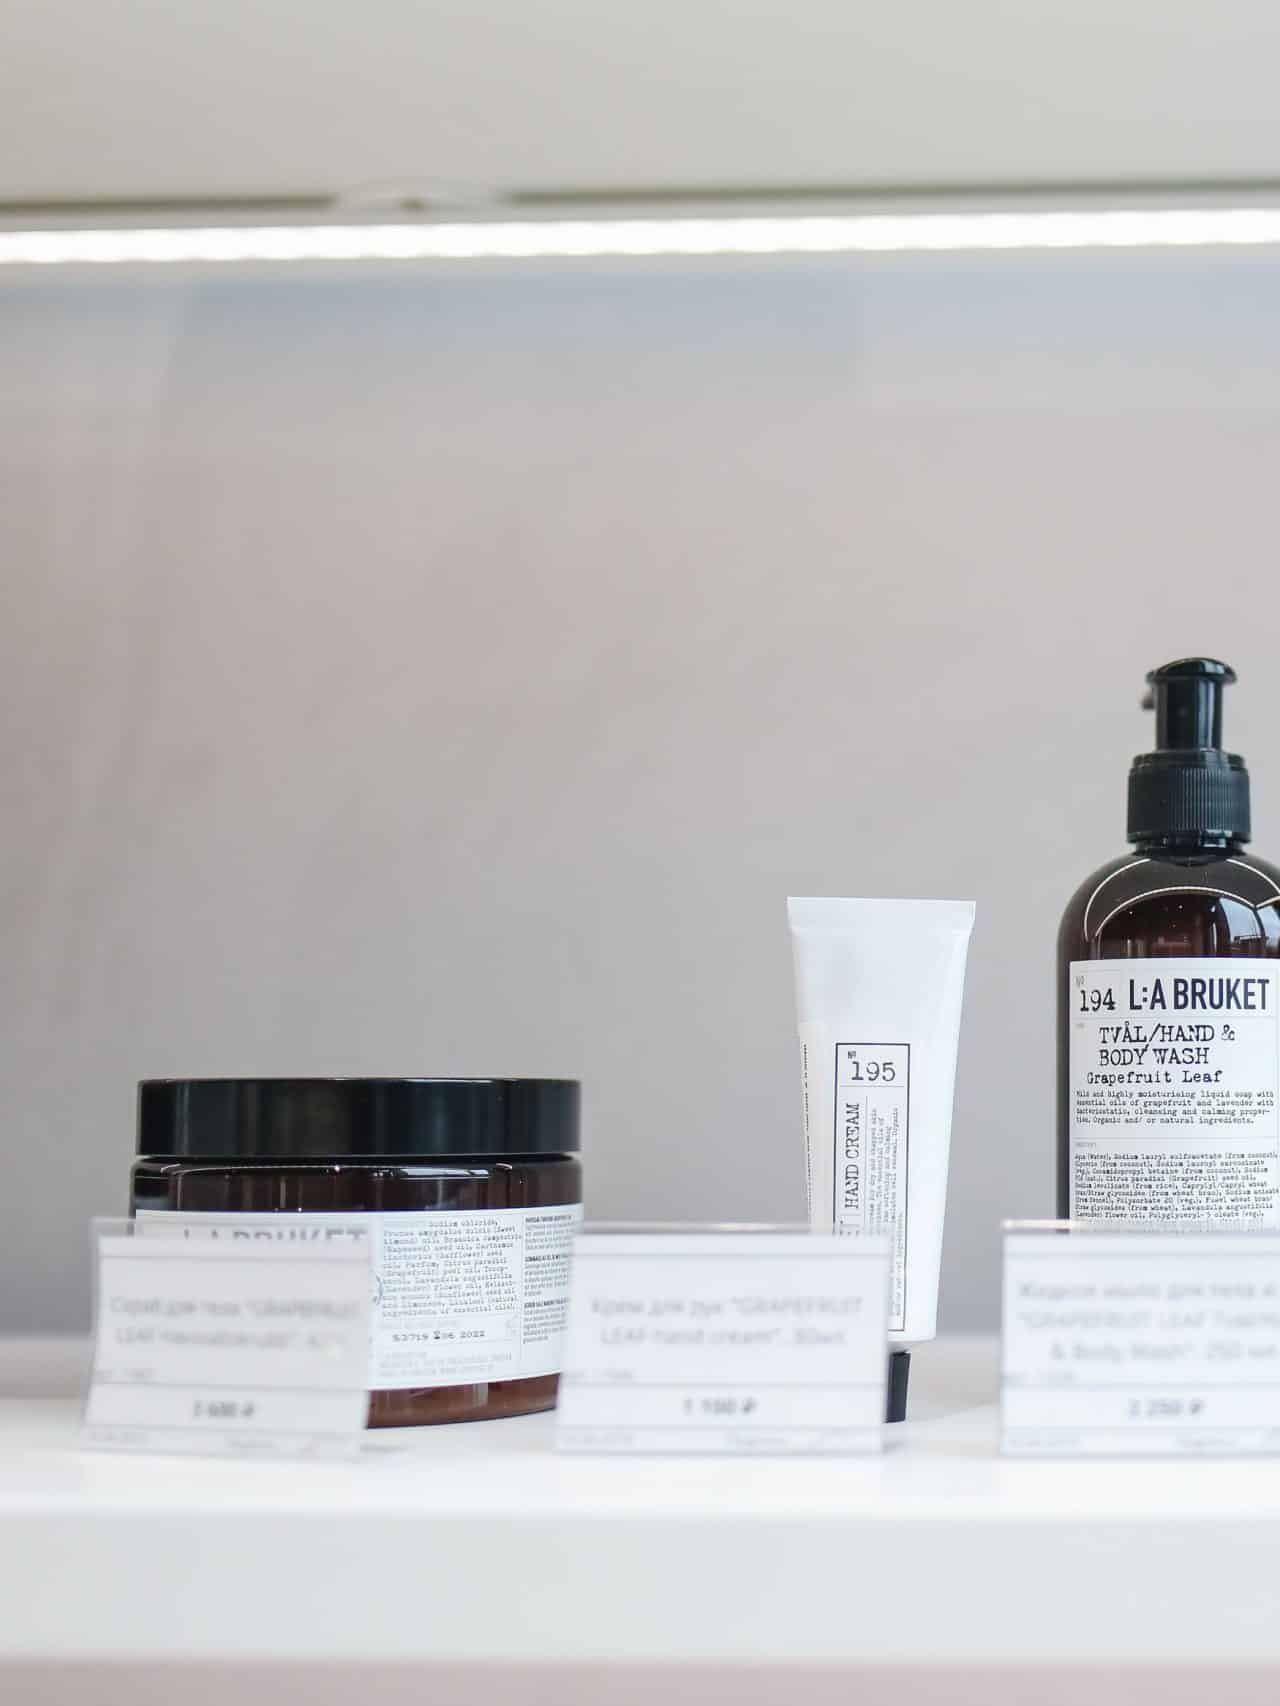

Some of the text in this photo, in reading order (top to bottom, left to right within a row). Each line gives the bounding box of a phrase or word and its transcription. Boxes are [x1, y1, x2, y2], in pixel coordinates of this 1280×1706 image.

[1080, 988, 1116, 1012] 194
[1130, 978, 1270, 1010] L:A BRUKET
[1099, 1020, 1215, 1044] TVÅL/HAND
[1099, 1047, 1210, 1066] BODY WASH
[851, 1061, 896, 1082] 195
[1087, 1070, 1223, 1086] Grapefruit Leaf
[1107, 1089, 1133, 1100] highly
[1138, 1089, 1196, 1100] moisturising
[1200, 1089, 1230, 1100] liquid
[1256, 1090, 1274, 1098] with
[1110, 1098, 1126, 1106] oils
[1143, 1098, 1192, 1108] grapefruit
[1216, 1098, 1253, 1106] lavender
[1256, 1098, 1274, 1106] with
[1093, 1115, 1120, 1125] Organic
[1159, 1115, 1194, 1124] natural
[1199, 1115, 1254, 1125] ingredients.
[1134, 1106, 1177, 1117] cleansing
[1181, 1107, 1197, 1115] and
[1201, 1106, 1236, 1117] calming
[1240, 1108, 1270, 1117] proper-
[844, 1104, 860, 1209] HAND CREAM
